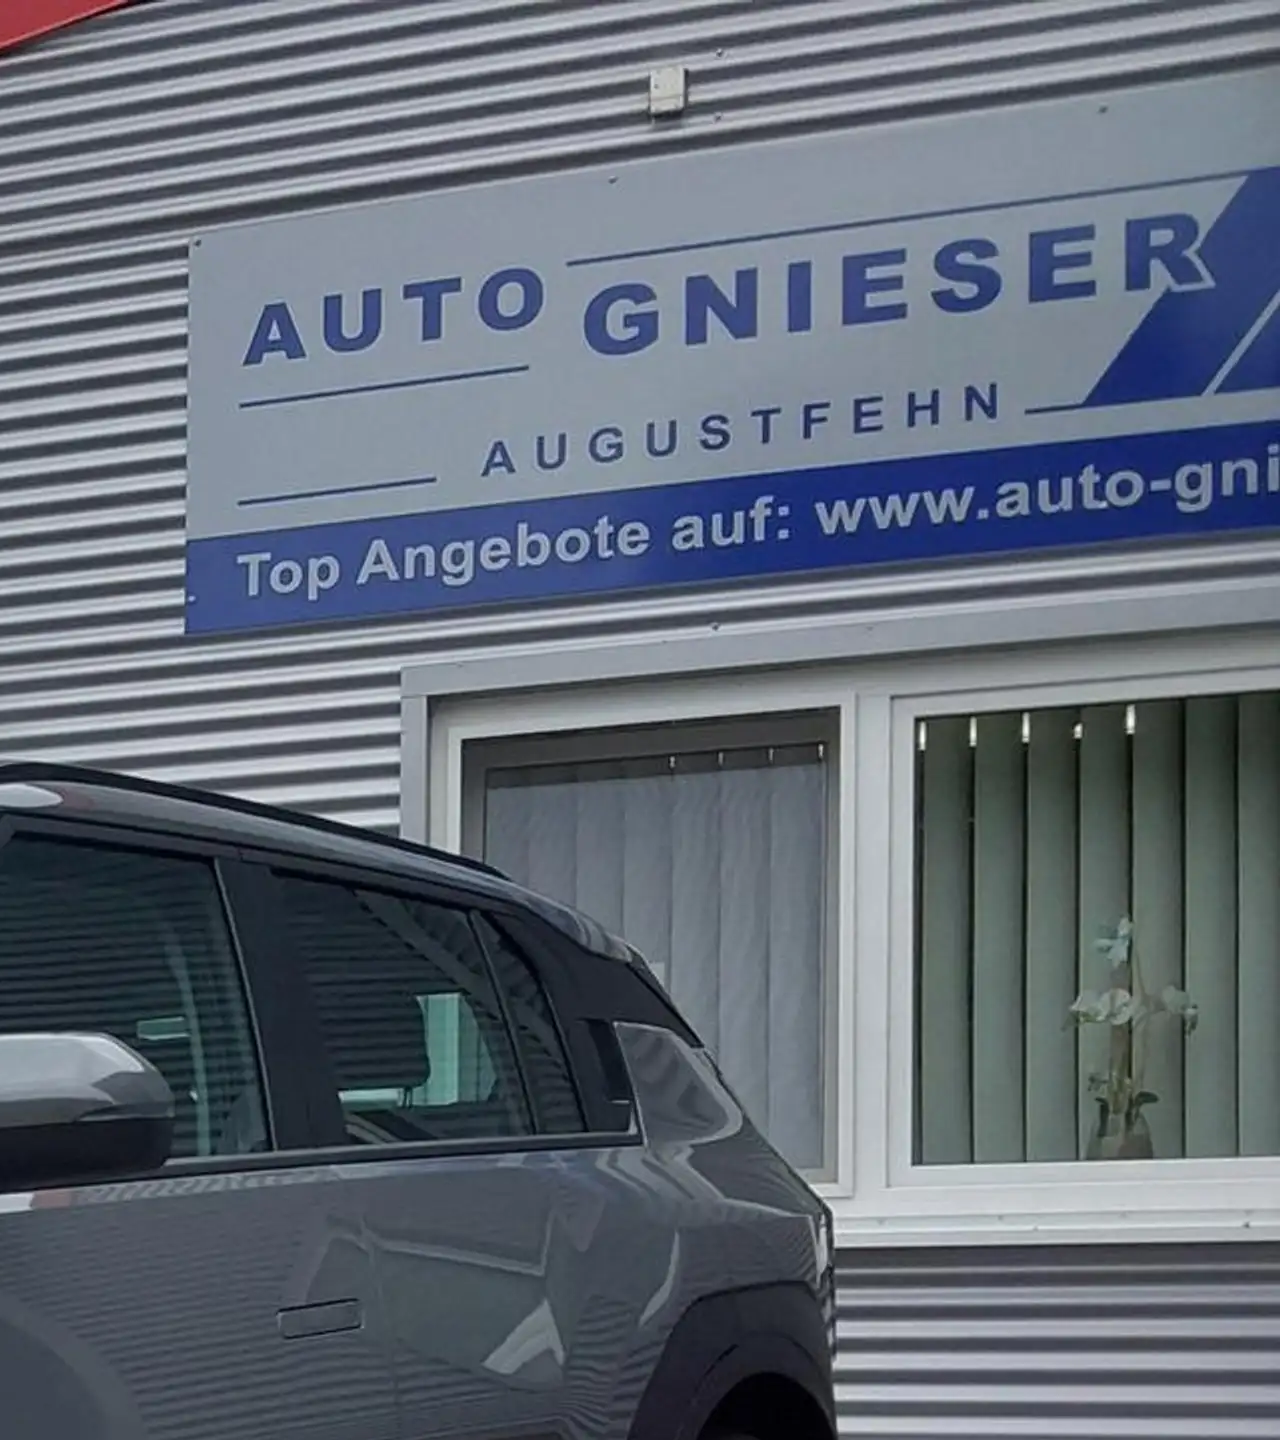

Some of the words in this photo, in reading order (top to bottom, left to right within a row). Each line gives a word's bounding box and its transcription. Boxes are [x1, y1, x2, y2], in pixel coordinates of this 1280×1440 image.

[242, 267, 544, 366] AUTO
[583, 213, 1204, 356] GNIESER
[481, 383, 998, 477] AUGUSTFEHN
[237, 553, 340, 600] Top
[356, 515, 650, 586] Angebote
[671, 495, 792, 551] auf:
[813, 444, 1280, 535] www.auto-gni
